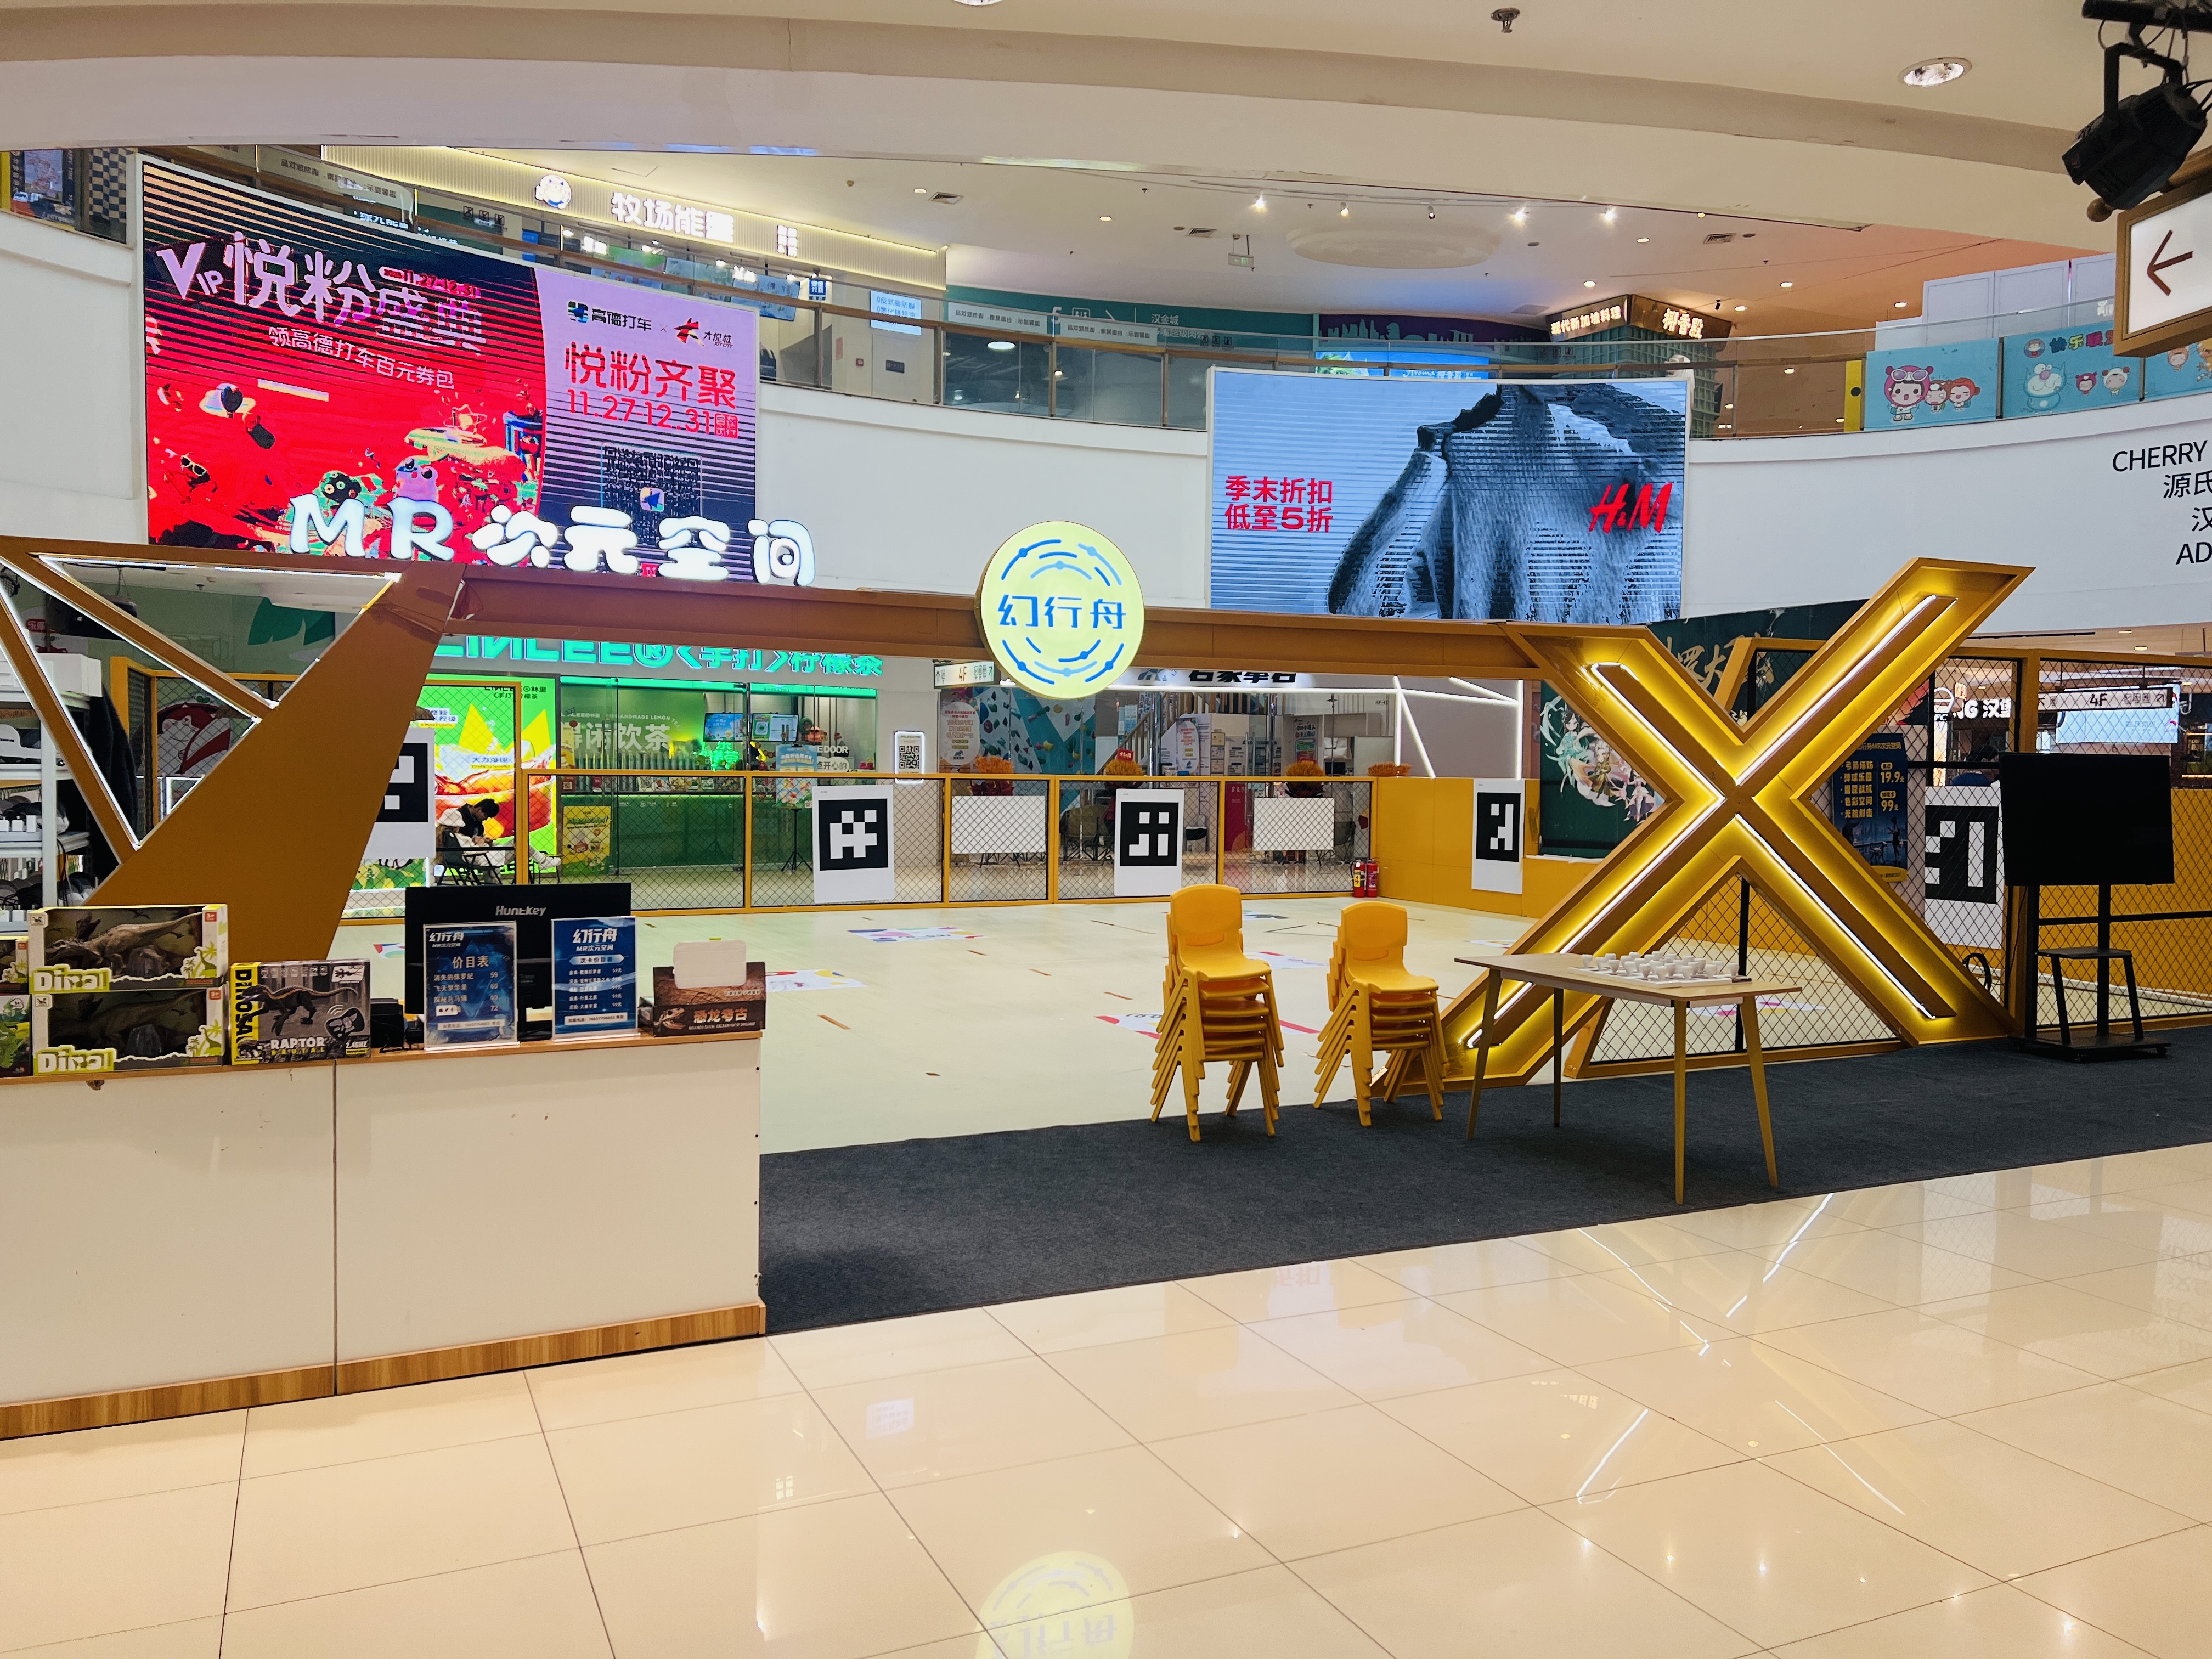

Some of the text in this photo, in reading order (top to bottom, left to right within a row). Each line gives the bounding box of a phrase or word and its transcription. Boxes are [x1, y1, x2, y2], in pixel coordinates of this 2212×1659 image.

[591, 307, 652, 331] 高德打车
[1151, 313, 1180, 325] 汉金城
[1550, 304, 1622, 335] 现代新加坡料理
[1662, 307, 1704, 340] 椰香殿
[703, 330, 732, 343] 大悦城
[268, 326, 455, 390] 领高德打车百元券包
[565, 341, 736, 409] 悦粉齐聚
[567, 388, 710, 435] 11.27-12.31
[2112, 439, 2208, 472] CHERRY
[1225, 475, 1333, 504] 季末折扣
[1588, 482, 1673, 534] H&M
[1225, 503, 1333, 533] 低至5折
[290, 494, 816, 586] MR 次元空间
[997, 594, 1127, 629] 幻行舟
[958, 665, 967, 682] 4F
[2089, 693, 2108, 707] 4F
[823, 745, 849, 754] DOOR
[1880, 771, 1905, 783] 19.9元
[1881, 799, 1899, 812] 99元
[428, 931, 465, 943] 幻行舟
[572, 928, 618, 944] 幻行舟
[576, 944, 614, 952] MR次元空间
[452, 955, 490, 969] 价目表
[433, 972, 474, 981] 消失的侏罗纪
[693, 1006, 748, 1024] 恐龙考古
[270, 1036, 325, 1050] RAPTOR
[271, 1047, 325, 1056] BRUTAL
